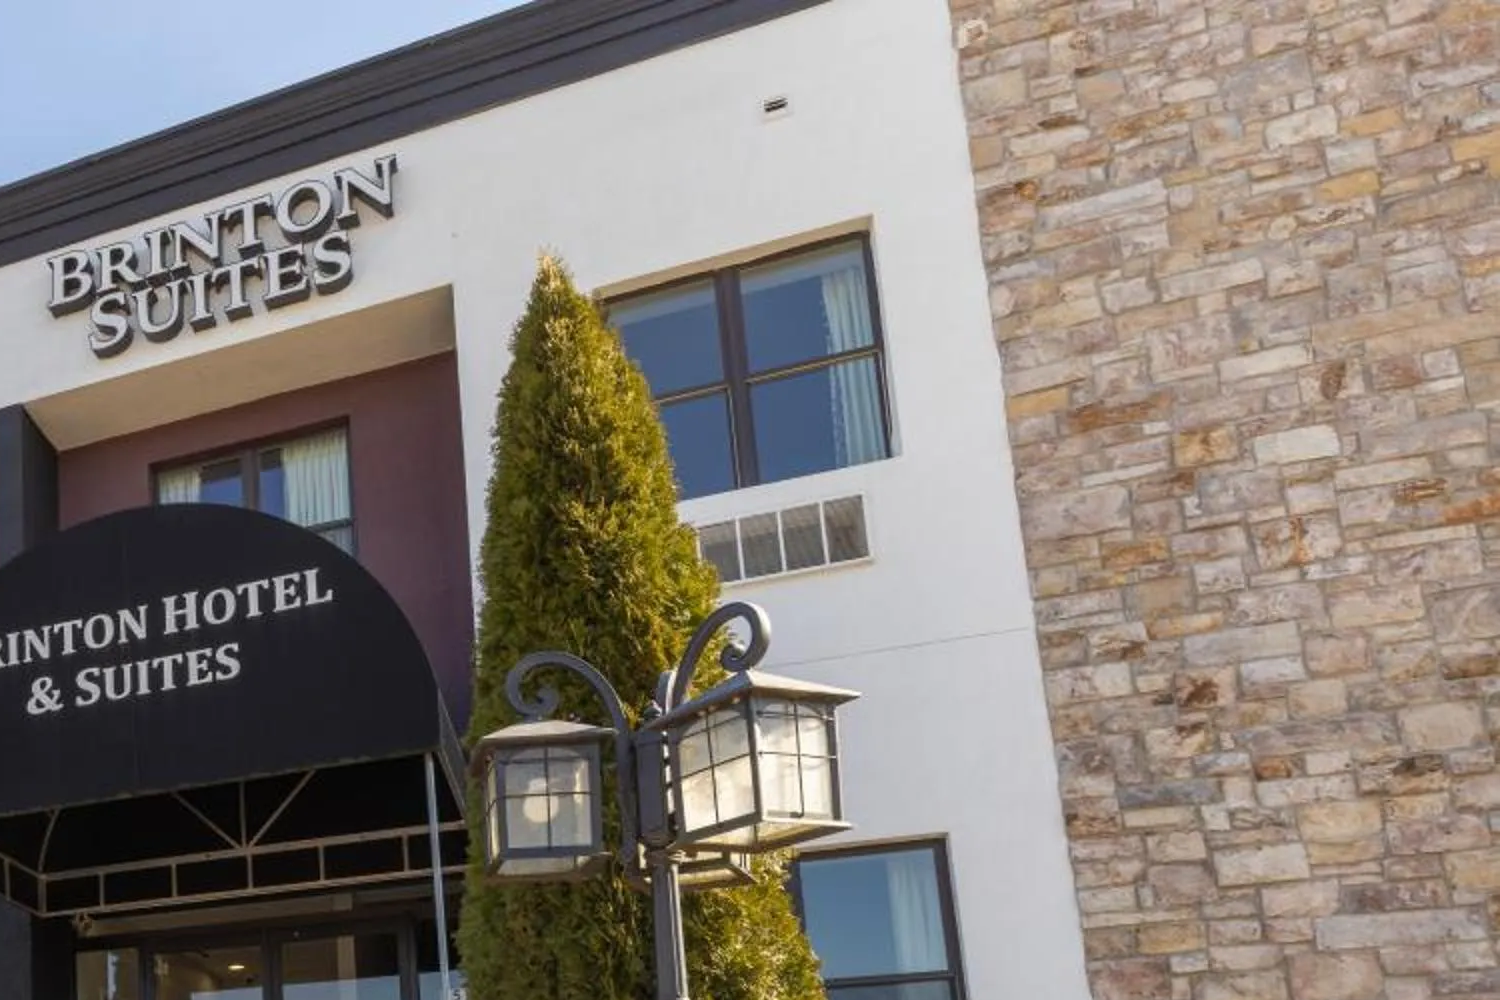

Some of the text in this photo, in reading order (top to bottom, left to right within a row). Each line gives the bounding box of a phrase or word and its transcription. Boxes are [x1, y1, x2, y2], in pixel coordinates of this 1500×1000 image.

[47, 153, 397, 314] BRINTON
[88, 231, 352, 356] SUITES
[162, 568, 333, 634] HOTEL
[26, 643, 242, 715] & SUITES
